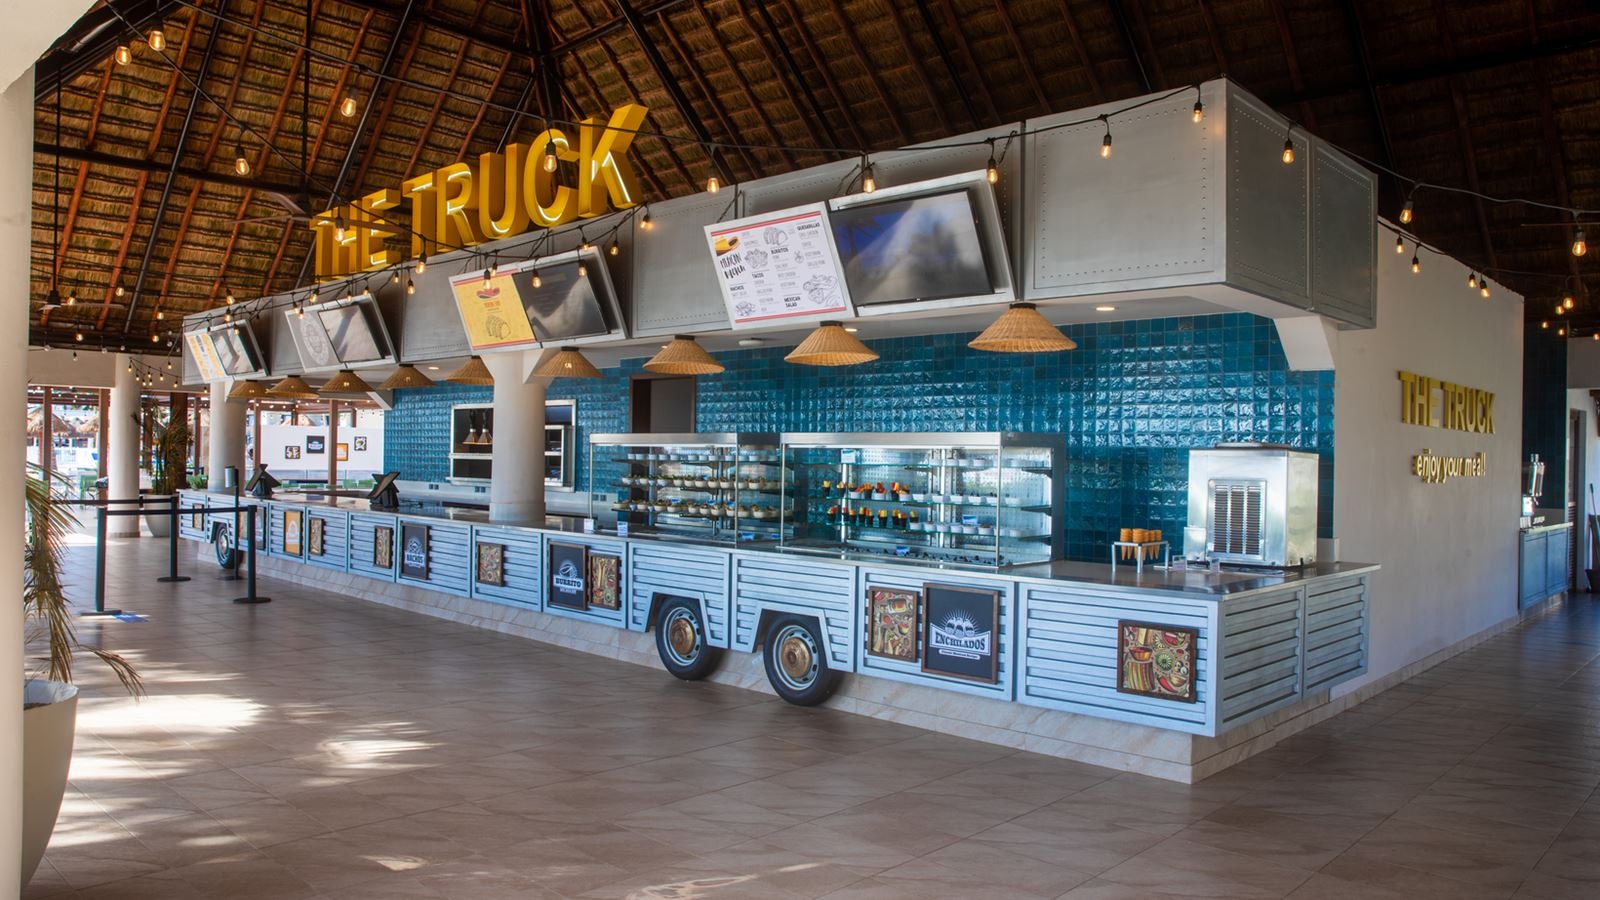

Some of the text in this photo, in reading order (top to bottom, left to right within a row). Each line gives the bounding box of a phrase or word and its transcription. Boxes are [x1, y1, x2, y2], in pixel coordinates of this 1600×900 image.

[310, 103, 648, 282] THE TRUCK
[1398, 371, 1495, 433] THE TRUCK
[1413, 448, 1441, 484] enjoy
[1442, 455, 1464, 484] your
[556, 578, 581, 587] BURRITO
[935, 632, 985, 650] ENCHILADOS
